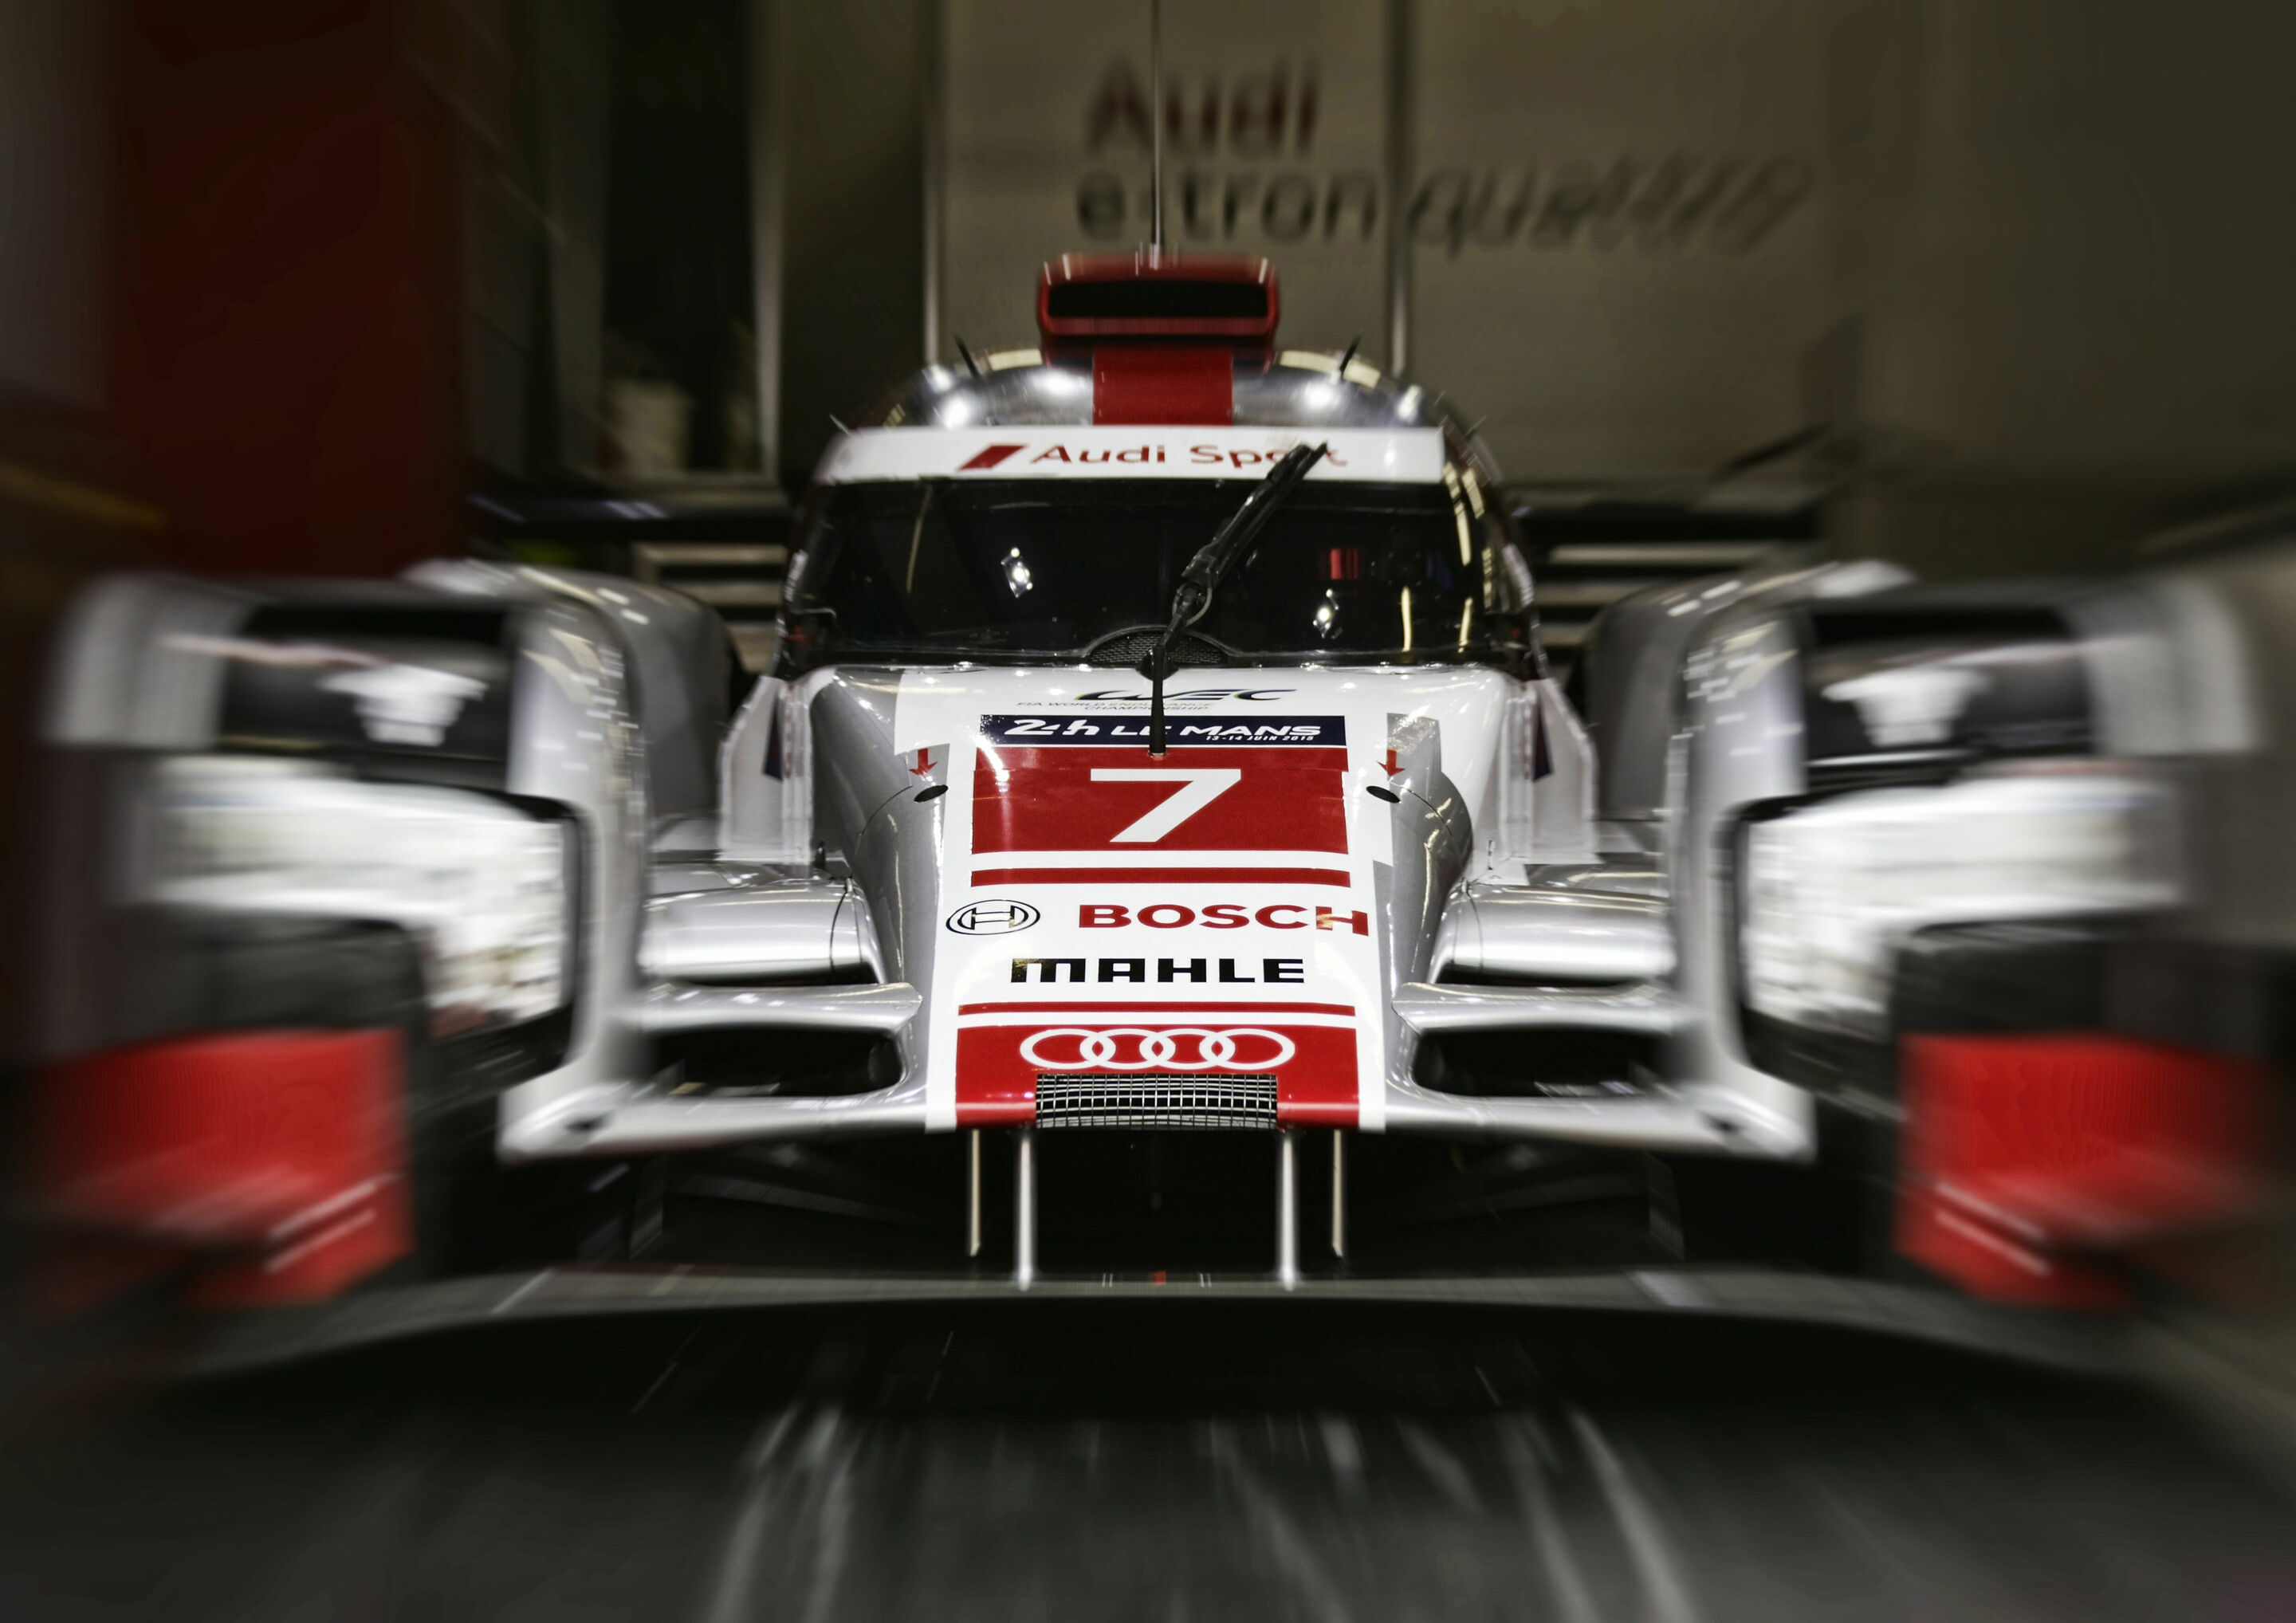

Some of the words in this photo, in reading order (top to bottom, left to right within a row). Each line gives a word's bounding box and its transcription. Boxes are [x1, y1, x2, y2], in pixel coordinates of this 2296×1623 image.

[1030, 443, 1166, 464] Audi
[1179, 725, 1321, 736] MANS
[1090, 768, 1242, 843] 7
[1079, 904, 1370, 937] BOSCH
[1010, 958, 1305, 984] MAHLE
